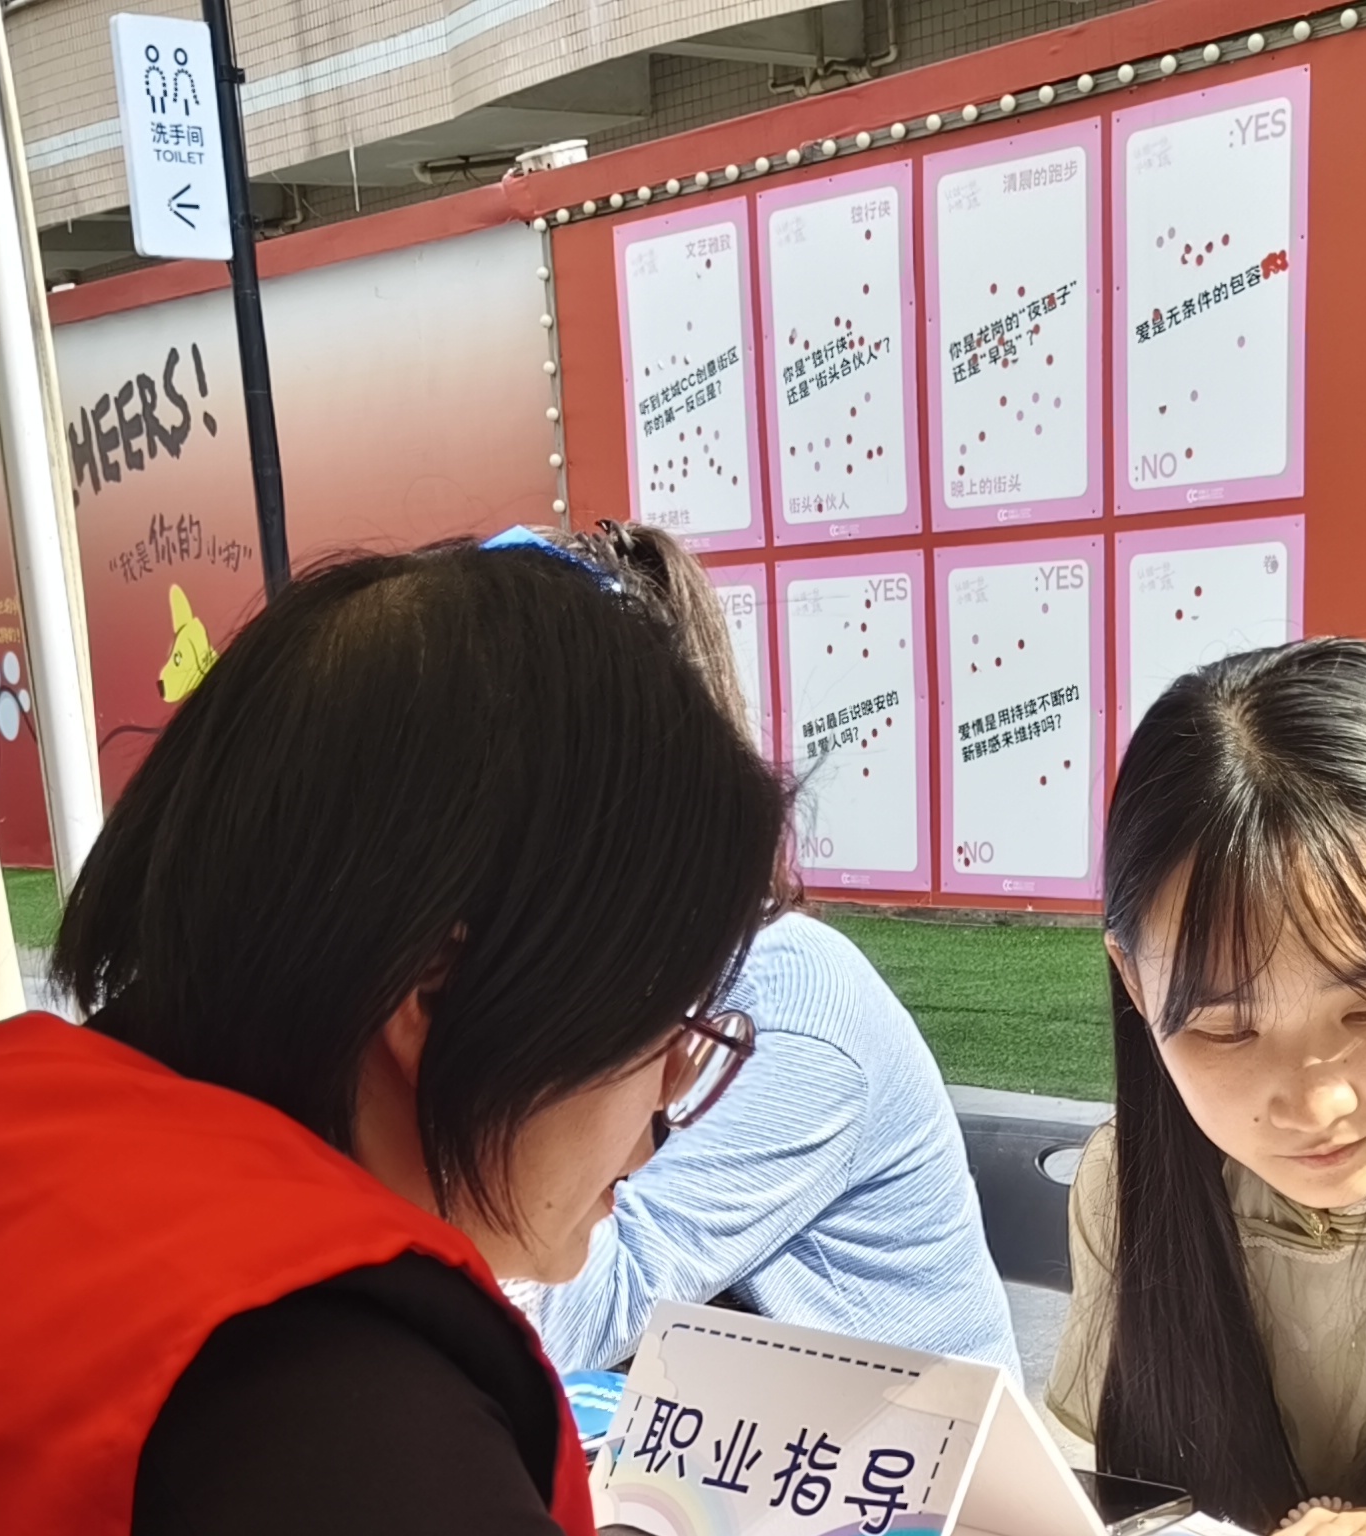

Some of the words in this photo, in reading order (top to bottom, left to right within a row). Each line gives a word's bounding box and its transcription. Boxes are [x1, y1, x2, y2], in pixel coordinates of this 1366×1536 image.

[150, 121, 204, 147] 洗手间
[153, 149, 205, 164] TOILET
[1002, 159, 1078, 194] 清晨的跑步
[850, 200, 891, 224] 独行侠
[69, 342, 217, 510] HEERS!
[950, 474, 1022, 498] 晚上的街头
[789, 492, 850, 515] 街头合伙人
[957, 684, 1080, 741] 爱情是用持续不断的
[633, 1397, 916, 1536] 职业指导
